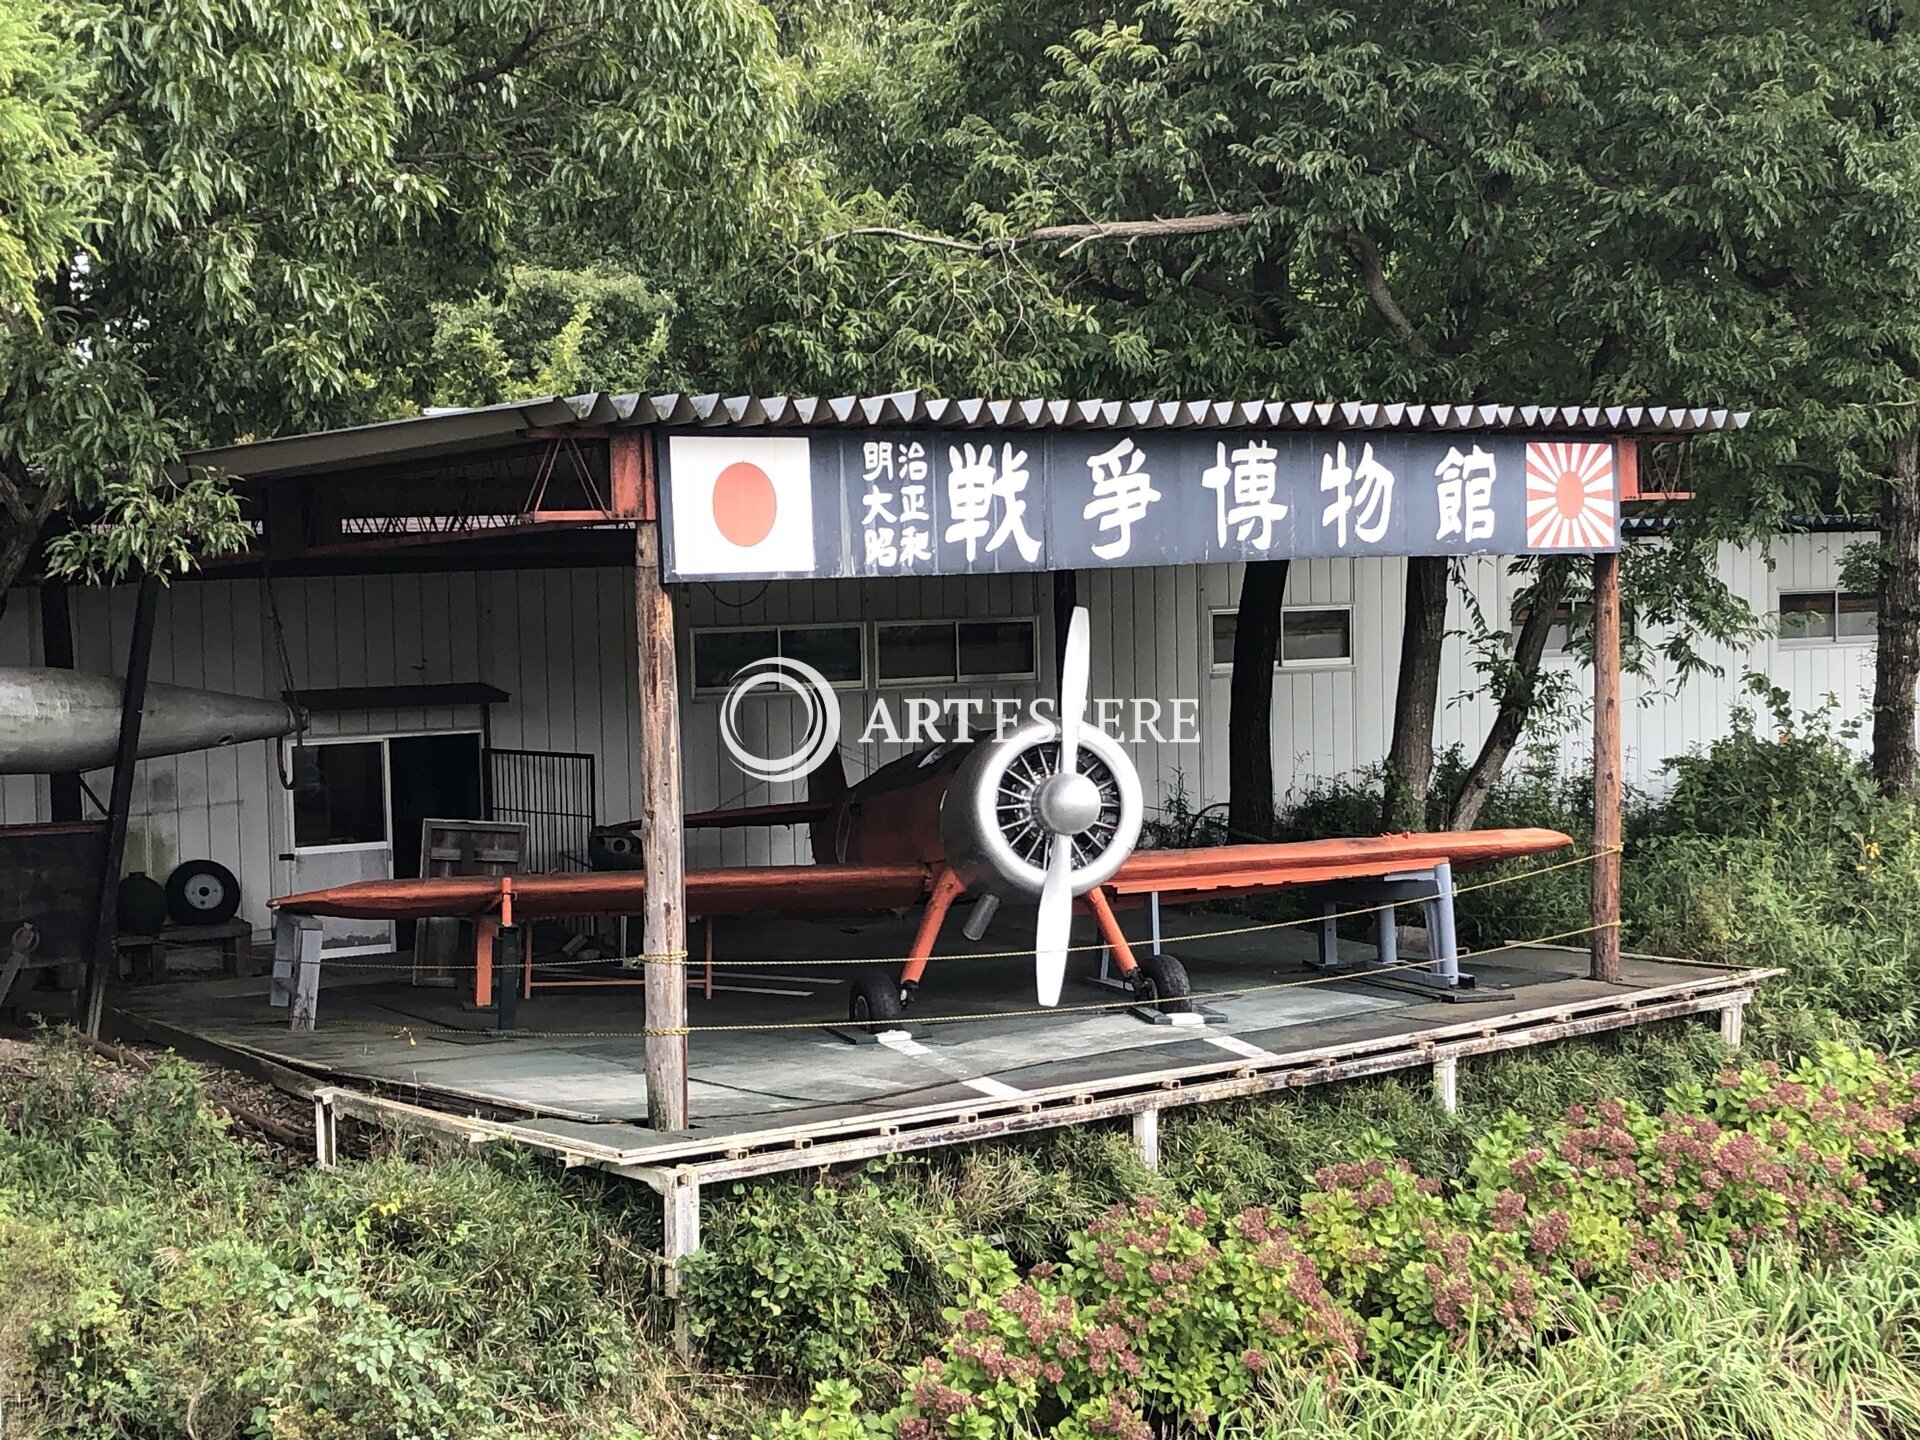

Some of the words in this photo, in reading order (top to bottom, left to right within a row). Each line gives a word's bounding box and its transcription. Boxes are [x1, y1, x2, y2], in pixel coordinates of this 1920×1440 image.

[862, 441, 928, 481] 明治
[861, 484, 930, 525] 大正
[864, 525, 932, 568] 昭和
